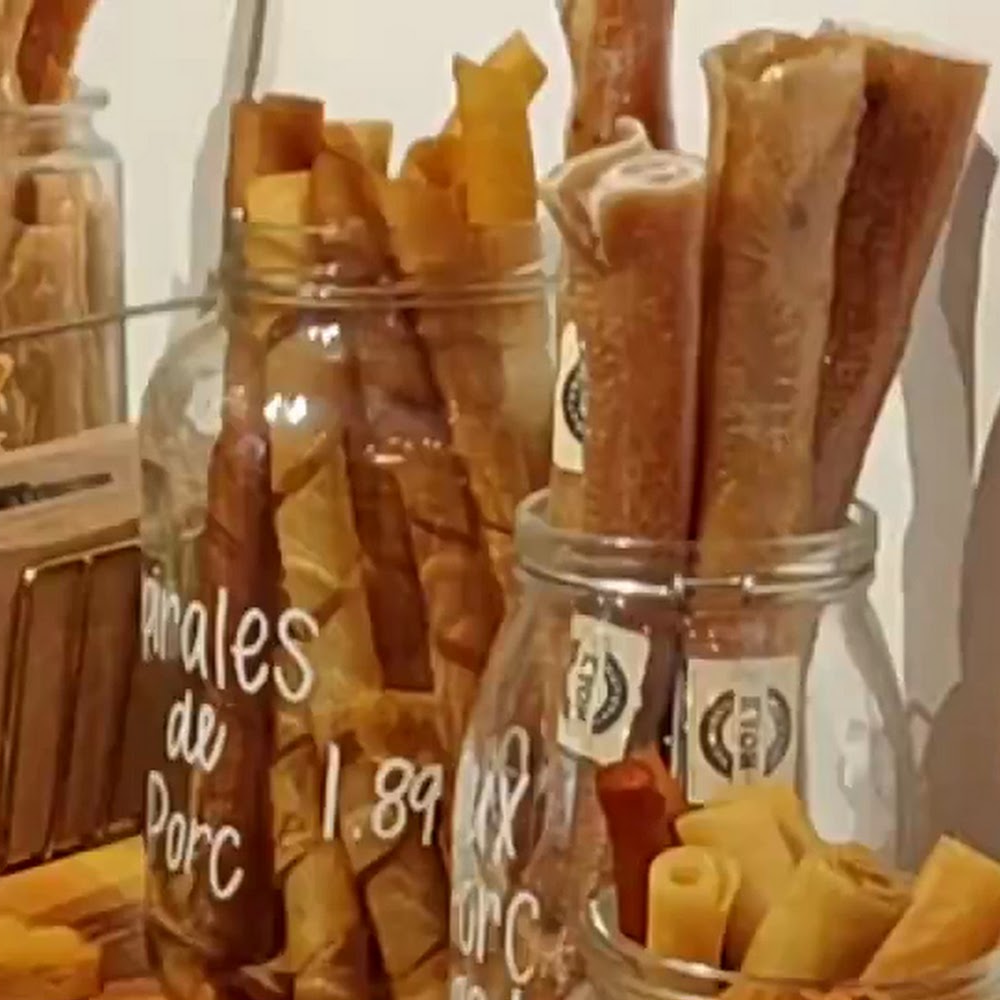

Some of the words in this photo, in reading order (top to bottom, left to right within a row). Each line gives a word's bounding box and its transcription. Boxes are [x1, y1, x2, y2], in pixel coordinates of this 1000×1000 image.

[167, 688, 227, 773] de
[148, 769, 245, 900] Porc
[322, 741, 444, 846] 1.89
